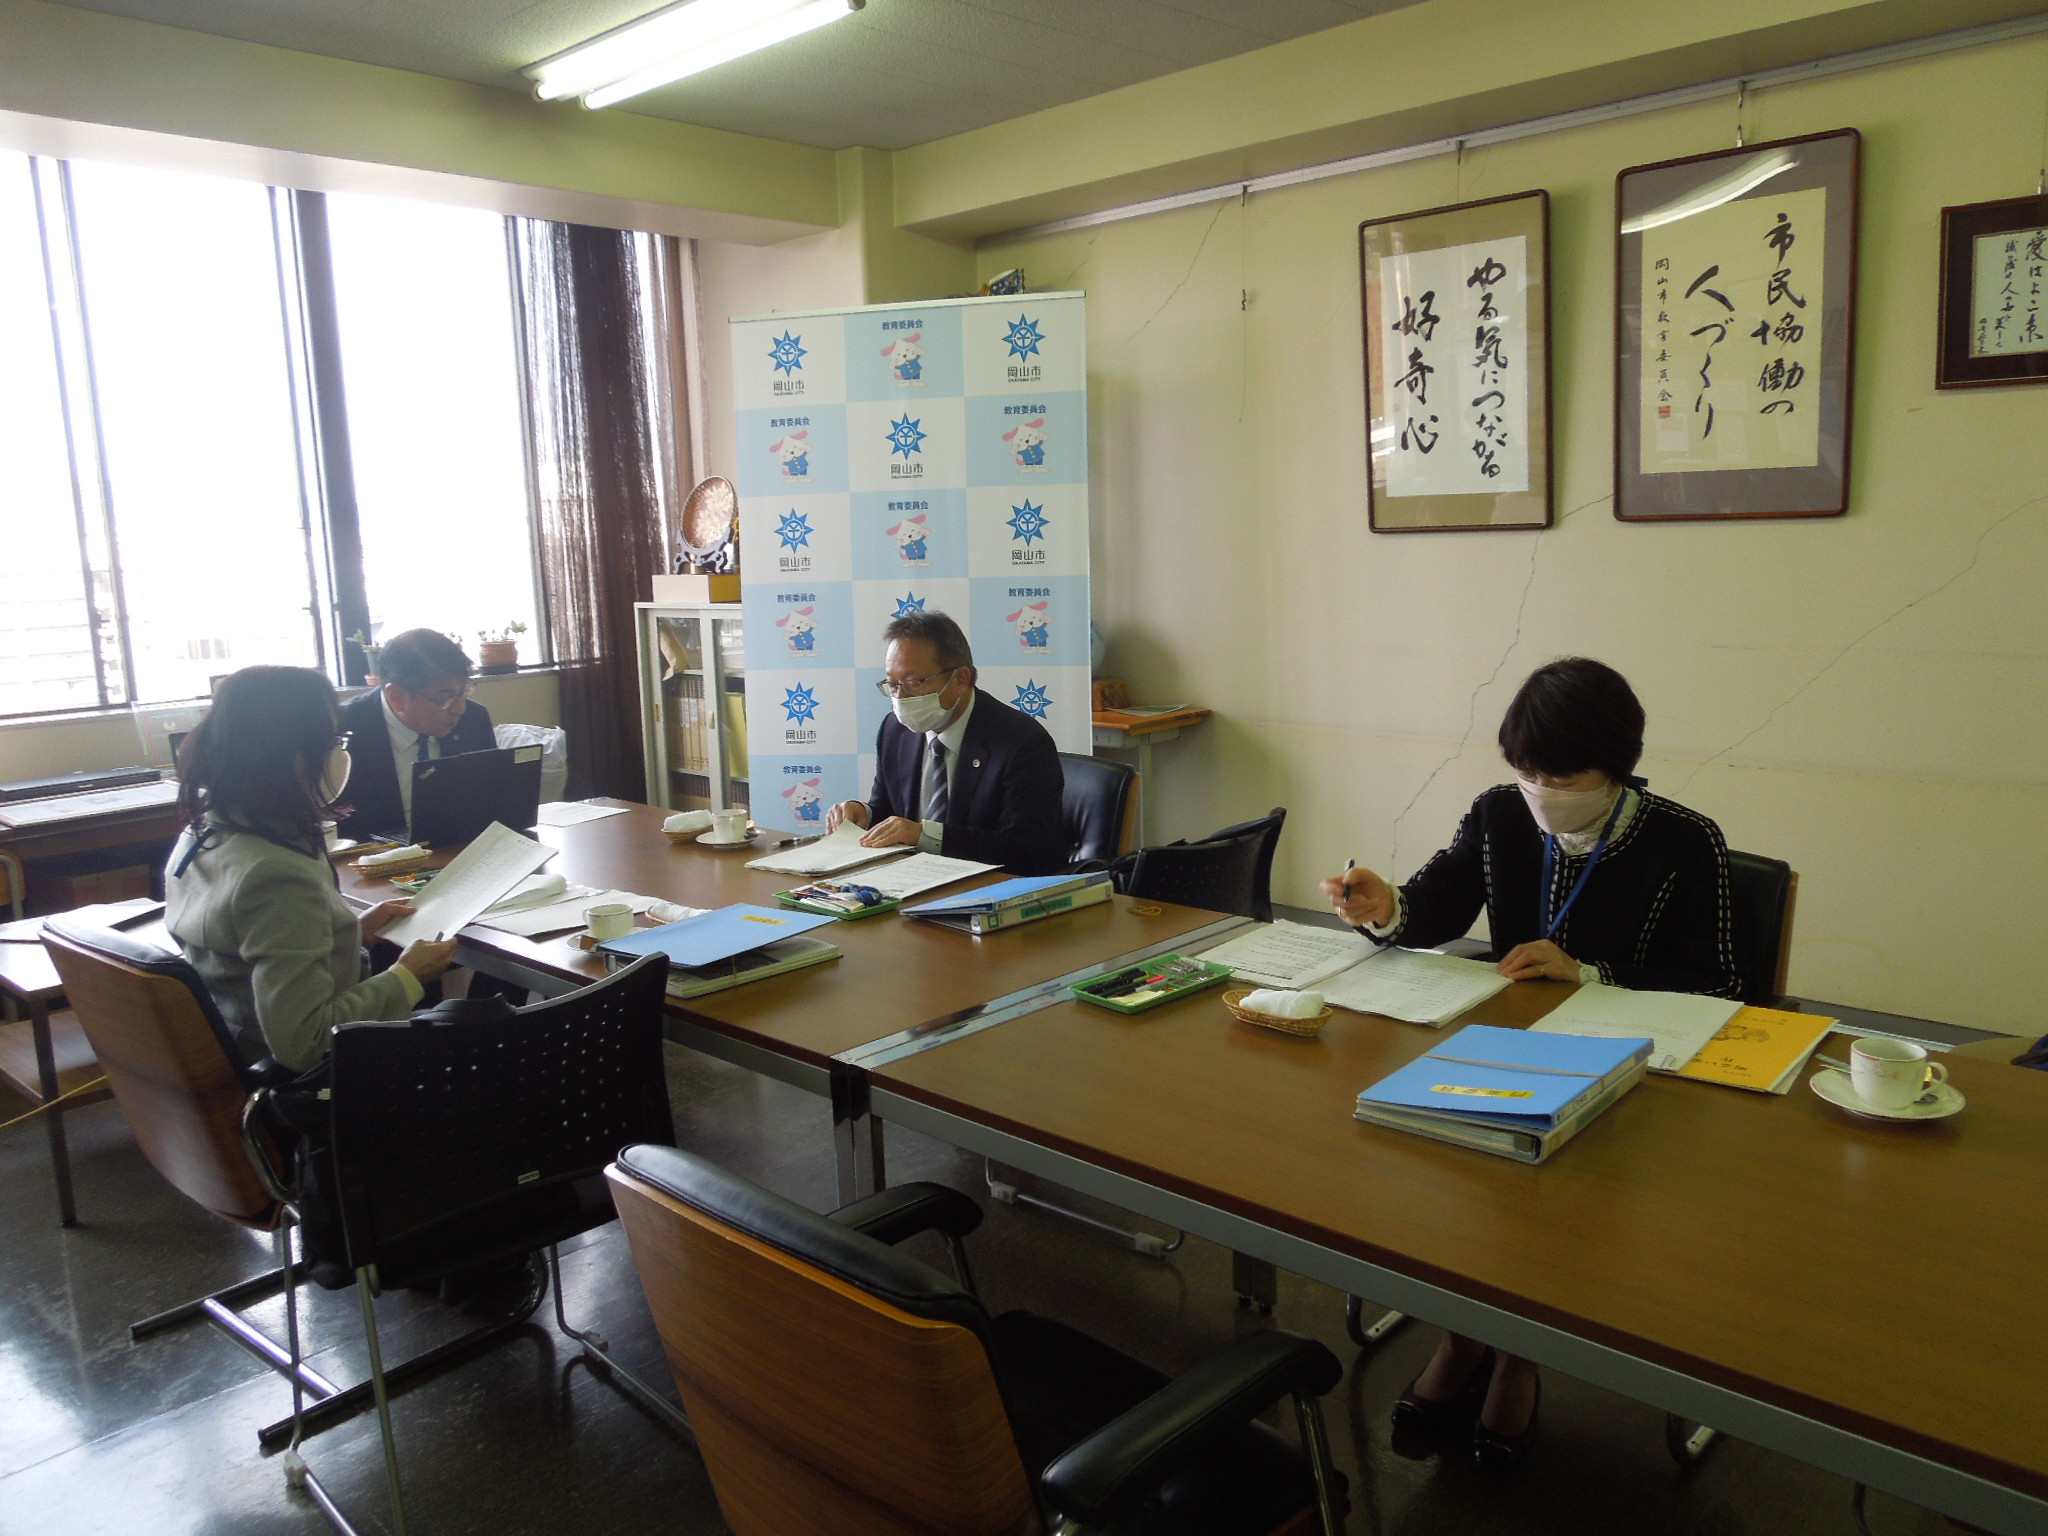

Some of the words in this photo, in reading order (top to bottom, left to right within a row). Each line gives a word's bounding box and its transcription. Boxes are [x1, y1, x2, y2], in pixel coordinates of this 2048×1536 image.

[1750, 212, 1806, 416] 市民協働の
[881, 318, 924, 331] 教育委員会
[1655, 257, 1673, 402] 岡山市教育委員会
[1684, 264, 1736, 439] 人づくり
[1007, 365, 1042, 377] 岡山市
[1392, 290, 1440, 454] 好奇心
[1467, 257, 1508, 478] やる気につながる
[773, 379, 805, 391] 岡山市
[1003, 404, 1047, 416] 教育委員会
[770, 416, 810, 428] 教育委員会
[890, 463, 924, 474] 岡山市
[887, 500, 929, 512] 教育委員会
[1011, 549, 1045, 561] 岡山市
[779, 556, 811, 568] 岡山市
[776, 592, 817, 604] 教育委員会
[1008, 587, 1051, 598] 教育委員会
[785, 729, 817, 740] 岡山市
[782, 764, 823, 775] 教育委員会
